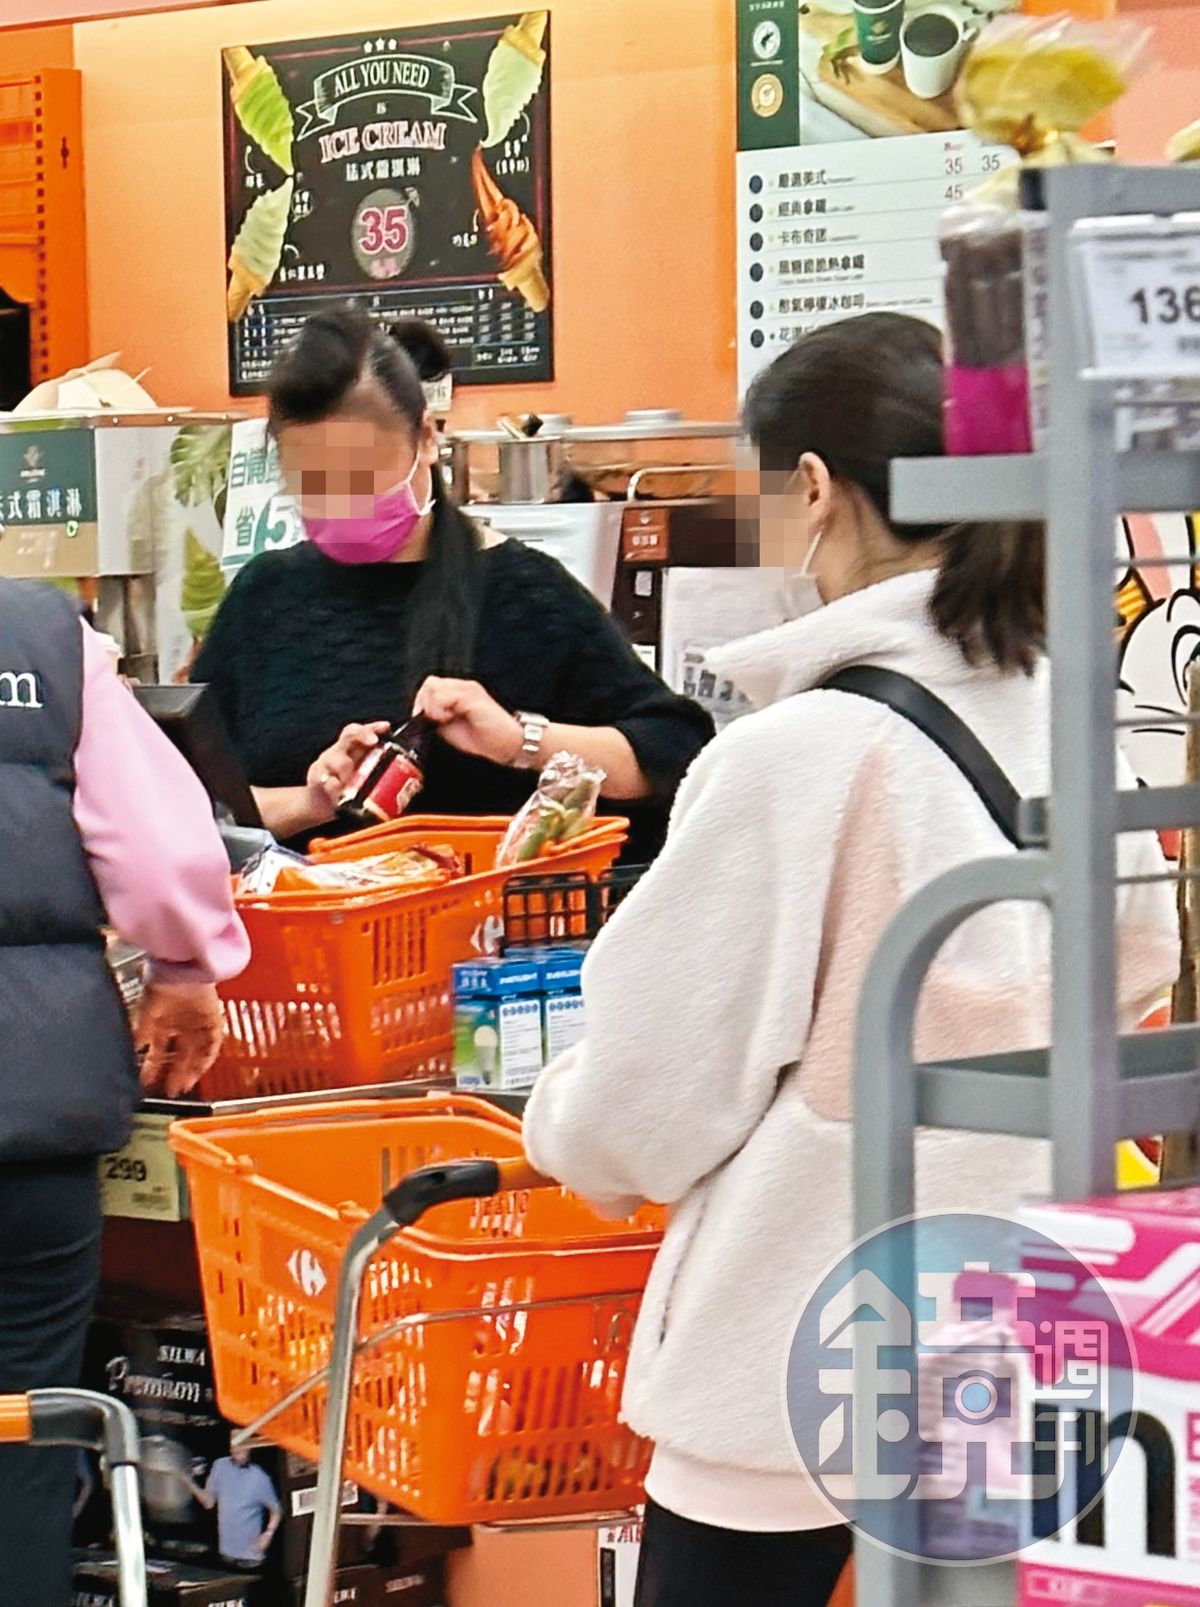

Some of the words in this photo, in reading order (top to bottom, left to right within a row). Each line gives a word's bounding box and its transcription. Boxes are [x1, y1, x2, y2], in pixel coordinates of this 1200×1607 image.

[333, 68, 360, 98] ALL
[360, 61, 391, 87] YOU
[393, 61, 430, 88] NEED
[319, 127, 361, 164] ICE
[361, 120, 447, 151] CREAM
[945, 157, 963, 176] 35
[982, 153, 1000, 172] 35
[945, 185, 964, 201] 45
[359, 205, 410, 255] 35
